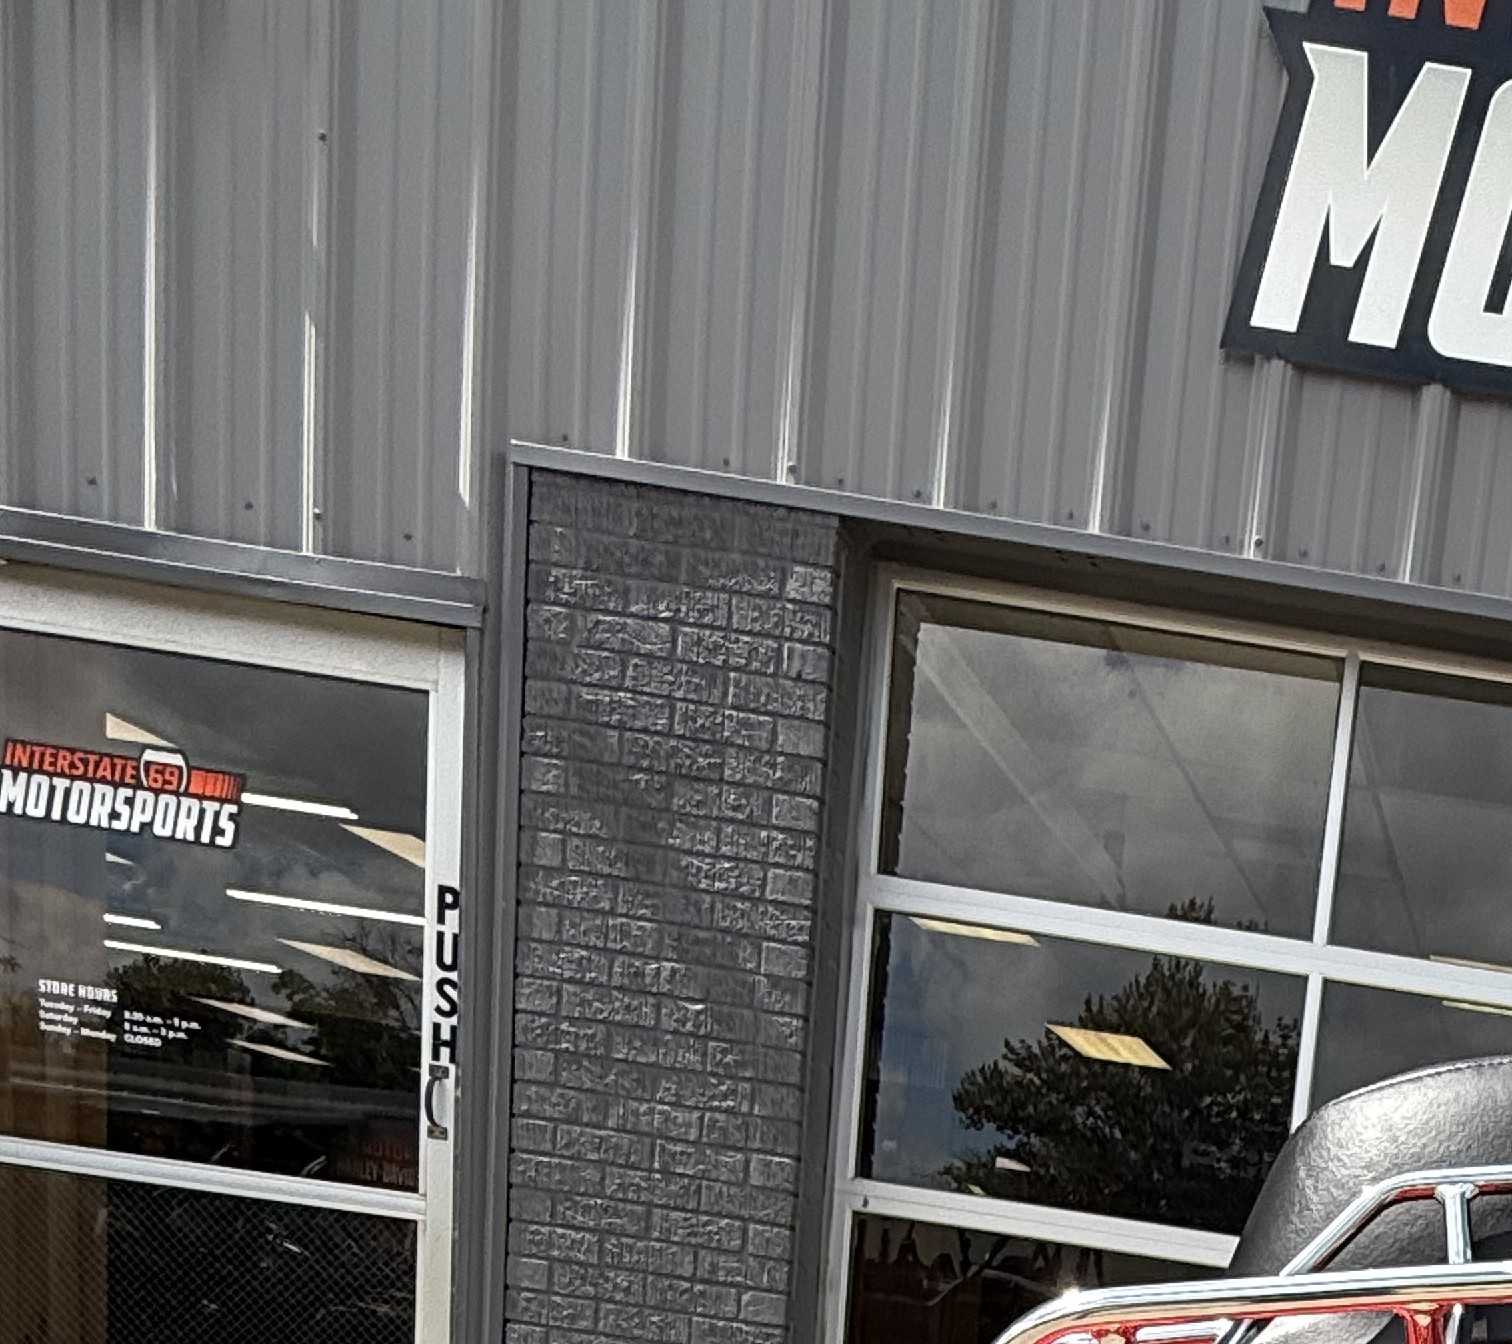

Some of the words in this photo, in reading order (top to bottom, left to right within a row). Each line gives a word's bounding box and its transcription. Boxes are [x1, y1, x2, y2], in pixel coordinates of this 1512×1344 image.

[4, 740, 138, 785] INTERSTATE
[150, 764, 180, 790] 69
[0, 768, 238, 848] MOTORSPORTS
[38, 978, 75, 997] STORE
[432, 884, 460, 1064] PUSH
